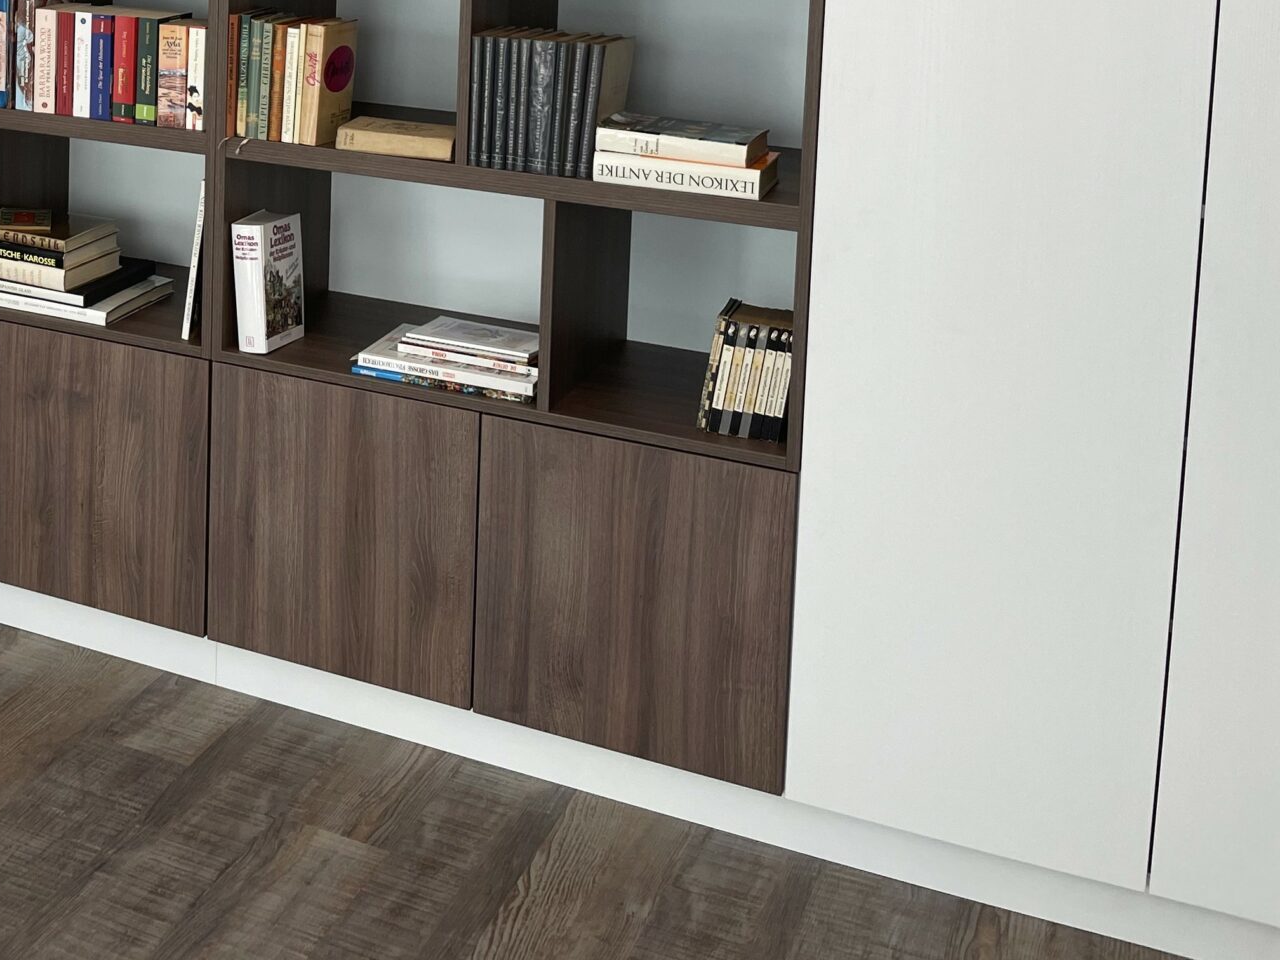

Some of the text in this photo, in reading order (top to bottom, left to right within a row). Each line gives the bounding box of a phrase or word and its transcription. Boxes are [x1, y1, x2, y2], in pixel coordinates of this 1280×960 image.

[262, 28, 271, 85] CHRISTIANE
[305, 51, 320, 86] Operette
[597, 163, 755, 194] LEXIKON DER ANTIKE
[272, 222, 291, 236] Omas
[270, 232, 295, 248] Lexikon
[24, 253, 56, 266] KAROSSE
[428, 369, 439, 377] DAS
